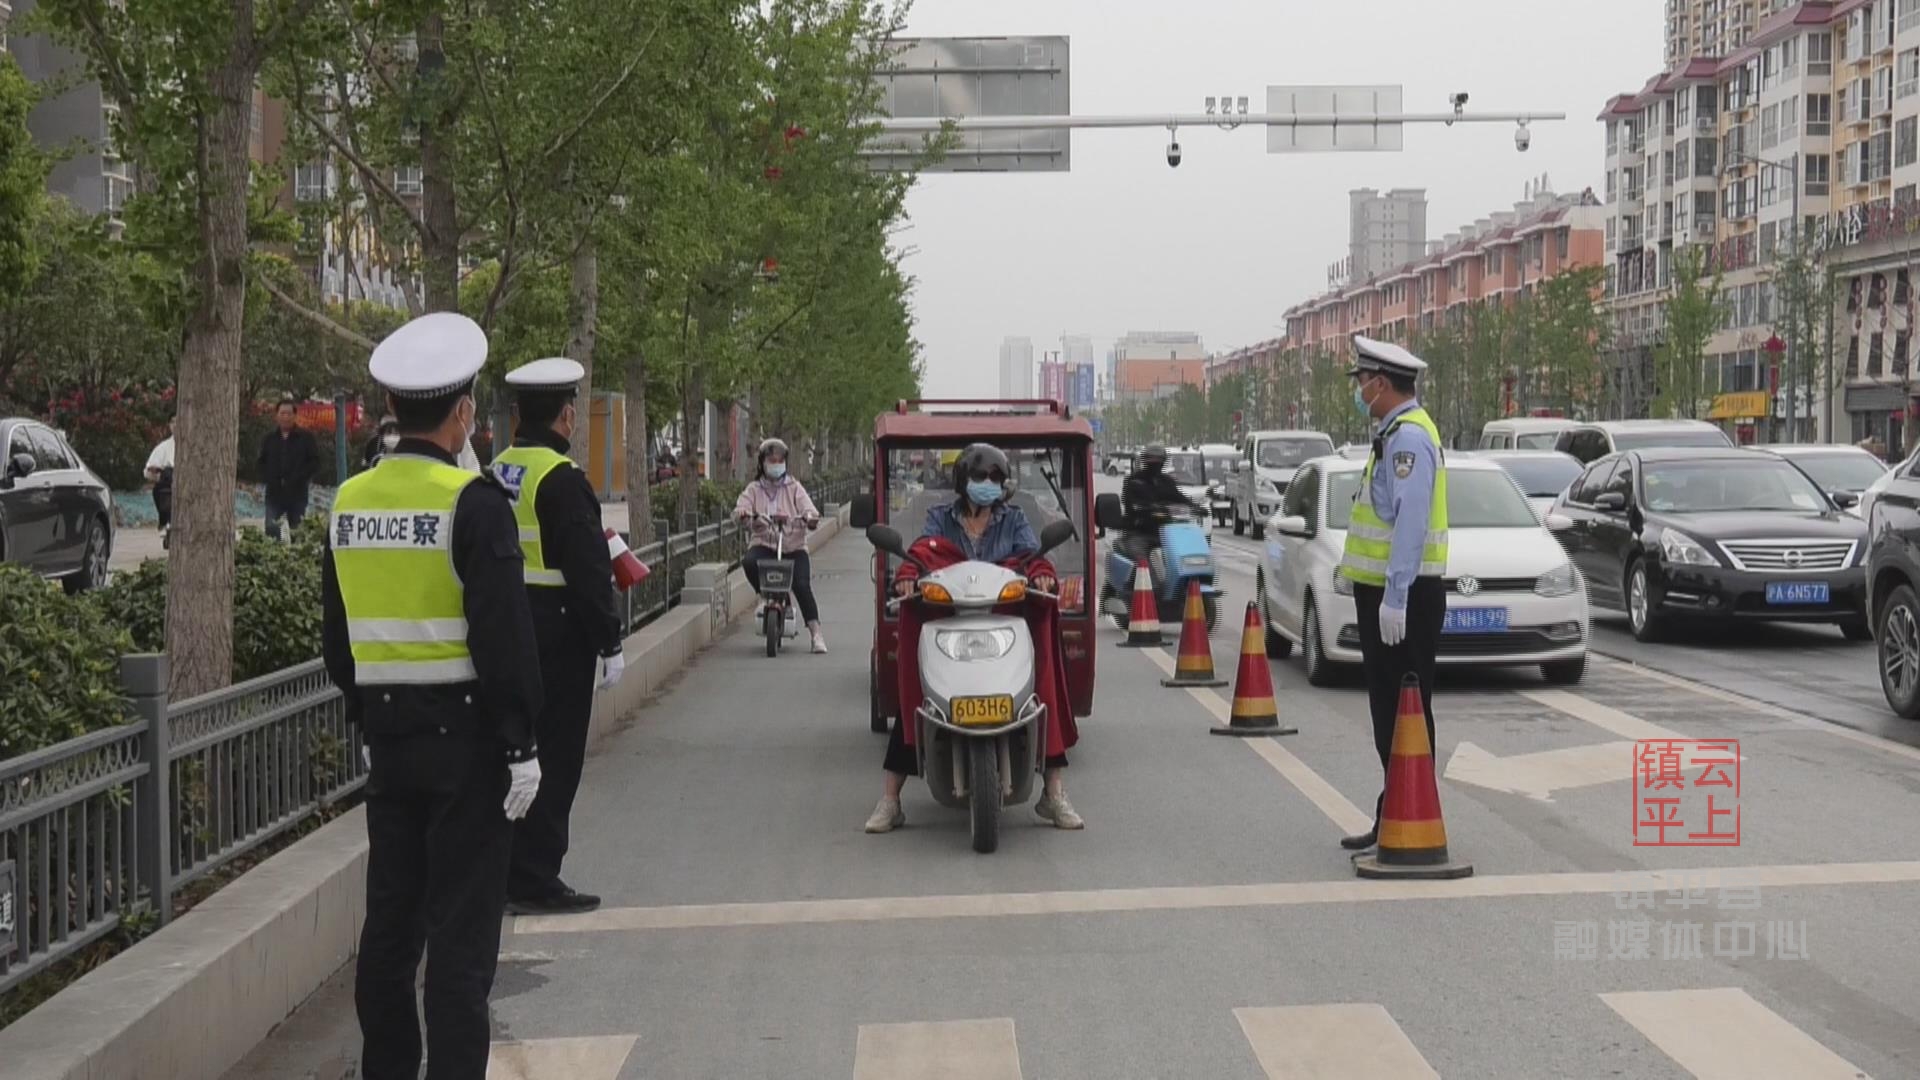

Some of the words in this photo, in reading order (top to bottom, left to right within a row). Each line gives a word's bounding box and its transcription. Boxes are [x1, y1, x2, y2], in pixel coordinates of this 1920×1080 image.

[357, 517, 409, 540] POLICE
[413, 512, 440, 545] 察
[955, 698, 1008, 717] 603H6
